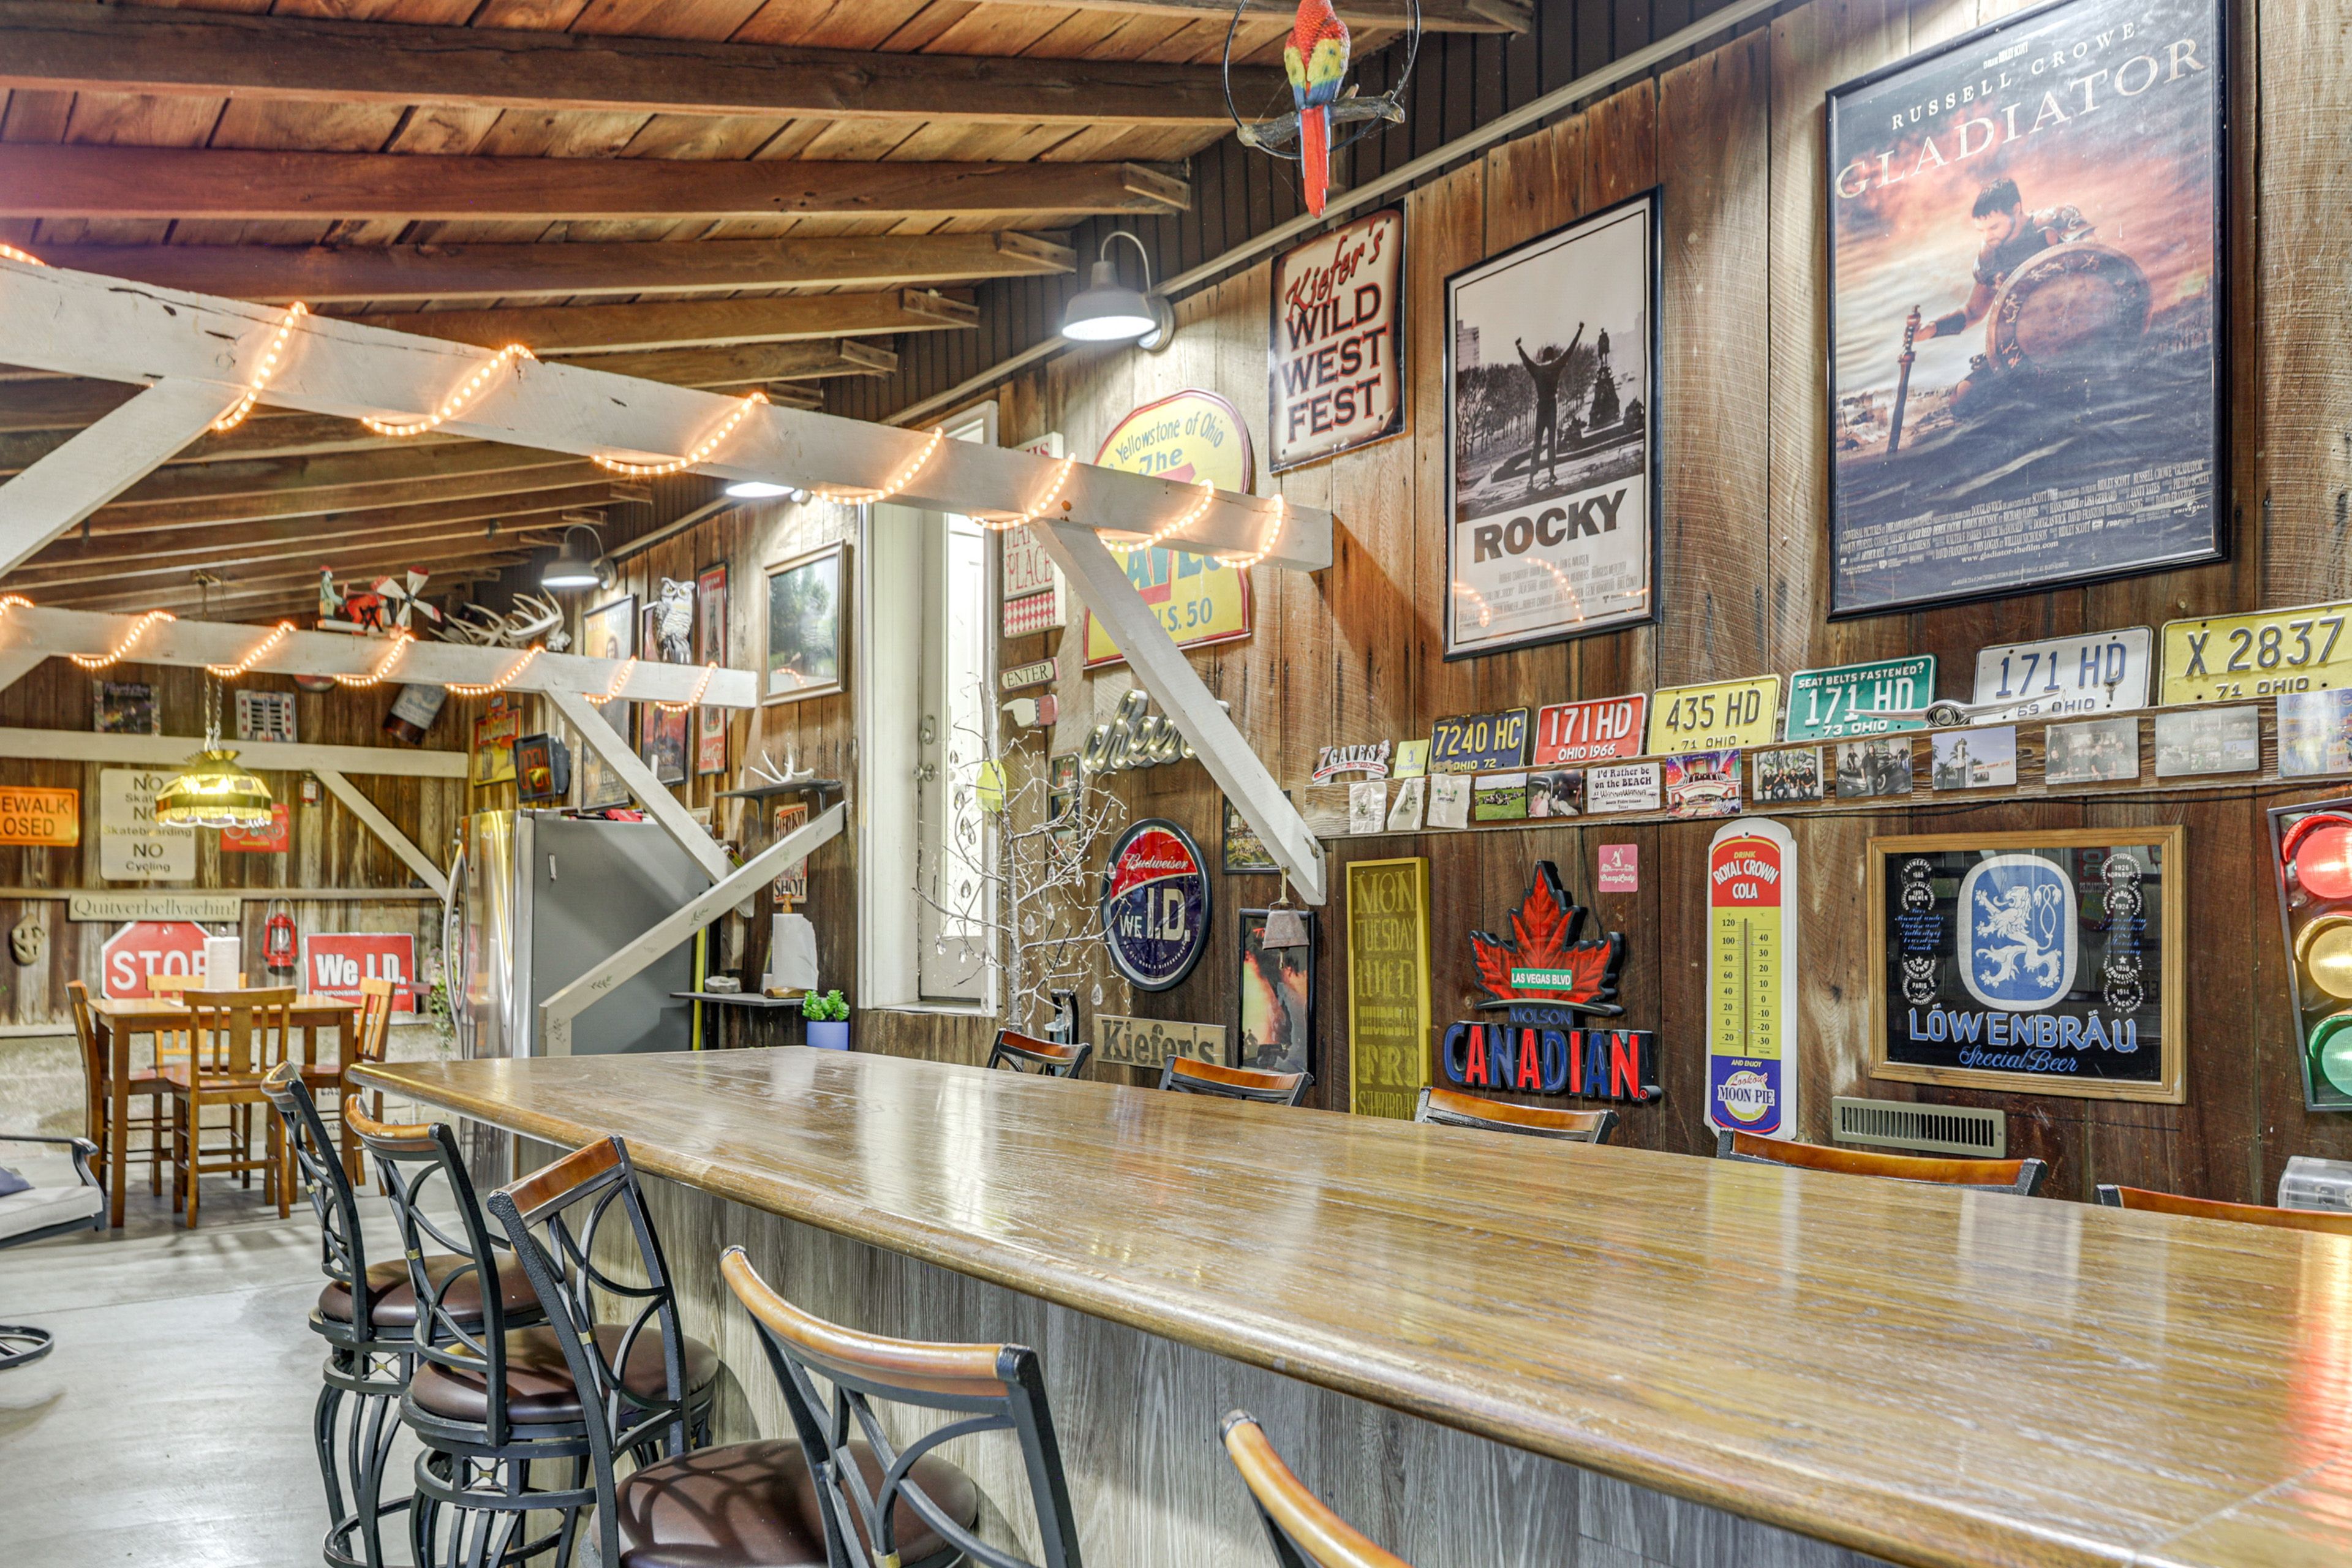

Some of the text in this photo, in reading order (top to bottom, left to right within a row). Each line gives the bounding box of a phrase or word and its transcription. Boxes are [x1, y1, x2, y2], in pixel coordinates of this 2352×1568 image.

[1892, 22, 2136, 130] RUSSELL CROWE
[1835, 38, 2205, 199] GLADIATOR
[1286, 217, 1384, 320] Kiefer's
[1286, 282, 1382, 351] WILD
[1281, 322, 1389, 399] WEST
[1287, 373, 1381, 443] FEST
[1115, 410, 1224, 464] Yellowstone of Ohio
[1139, 447, 1183, 475] The
[2174, 503, 2208, 514] UNIVERSAL
[1474, 488, 1627, 564] ROCKY
[1961, 540, 2059, 563] www.gladiator-thefilm.com
[1006, 545, 1053, 591] PLACE
[1187, 598, 1212, 627] 50
[2185, 616, 2345, 677] X 2837
[1006, 664, 1049, 687] ENTER
[1798, 662, 1924, 689] SEAT BELTS FASTENED?
[1996, 643, 2126, 699] 171 HD
[2216, 676, 2310, 699] 71 OHIO
[1666, 689, 1761, 732] 435 HD
[1805, 677, 1914, 726] 171 HD
[2018, 698, 2095, 717] 69 OHIO
[1436, 717, 1521, 756] 7240 HC
[1550, 703, 1632, 747] 171 HD
[1823, 720, 1888, 736] 73 OHIO
[1558, 744, 1616, 761] OHIO 1966
[1682, 735, 1736, 750] 71 OHIO
[519, 747, 550, 790] OPEN
[1319, 744, 1376, 769] 7 CAVES
[1453, 758, 1496, 771] OHIO 72
[134, 776, 164, 791] NO
[1597, 770, 1607, 778] I'd
[1610, 768, 1638, 777] Rather
[1623, 777, 1651, 786] BEACH
[126, 794, 156, 804] Skat
[0, 817, 55, 836] OSED
[134, 843, 164, 858] NO
[1125, 853, 1188, 870] Budweiser
[126, 861, 170, 872] Cycling
[1713, 859, 1779, 885] ROYAL CROWN
[775, 879, 804, 897] SHOT
[1353, 870, 1417, 914] MON
[1732, 883, 1758, 899] COLA
[2110, 891, 2134, 905] HAMBURG
[74, 897, 236, 918] Quityerbellyachin!
[1120, 888, 1191, 942] WE I.D.
[1355, 918, 1417, 952] TUESDAY
[315, 953, 407, 987] We I.D.
[1512, 972, 1571, 986] LAS VEGAS BLVD
[2108, 967, 2137, 980] BRUXELLES
[1359, 1006, 1417, 1036] THURSDAY
[1510, 1008, 1572, 1025] MOLSON
[1908, 1003, 2139, 1054] LÖWENBRÄU
[1102, 1019, 1215, 1066] Kiefer's
[1358, 1044, 1419, 1087] FRI
[1444, 1022, 1640, 1099] CANADIAN
[1959, 1044, 2078, 1072] Special Beer
[1730, 1072, 1768, 1086] Lookout
[1719, 1087, 1773, 1104] MOON PIE
